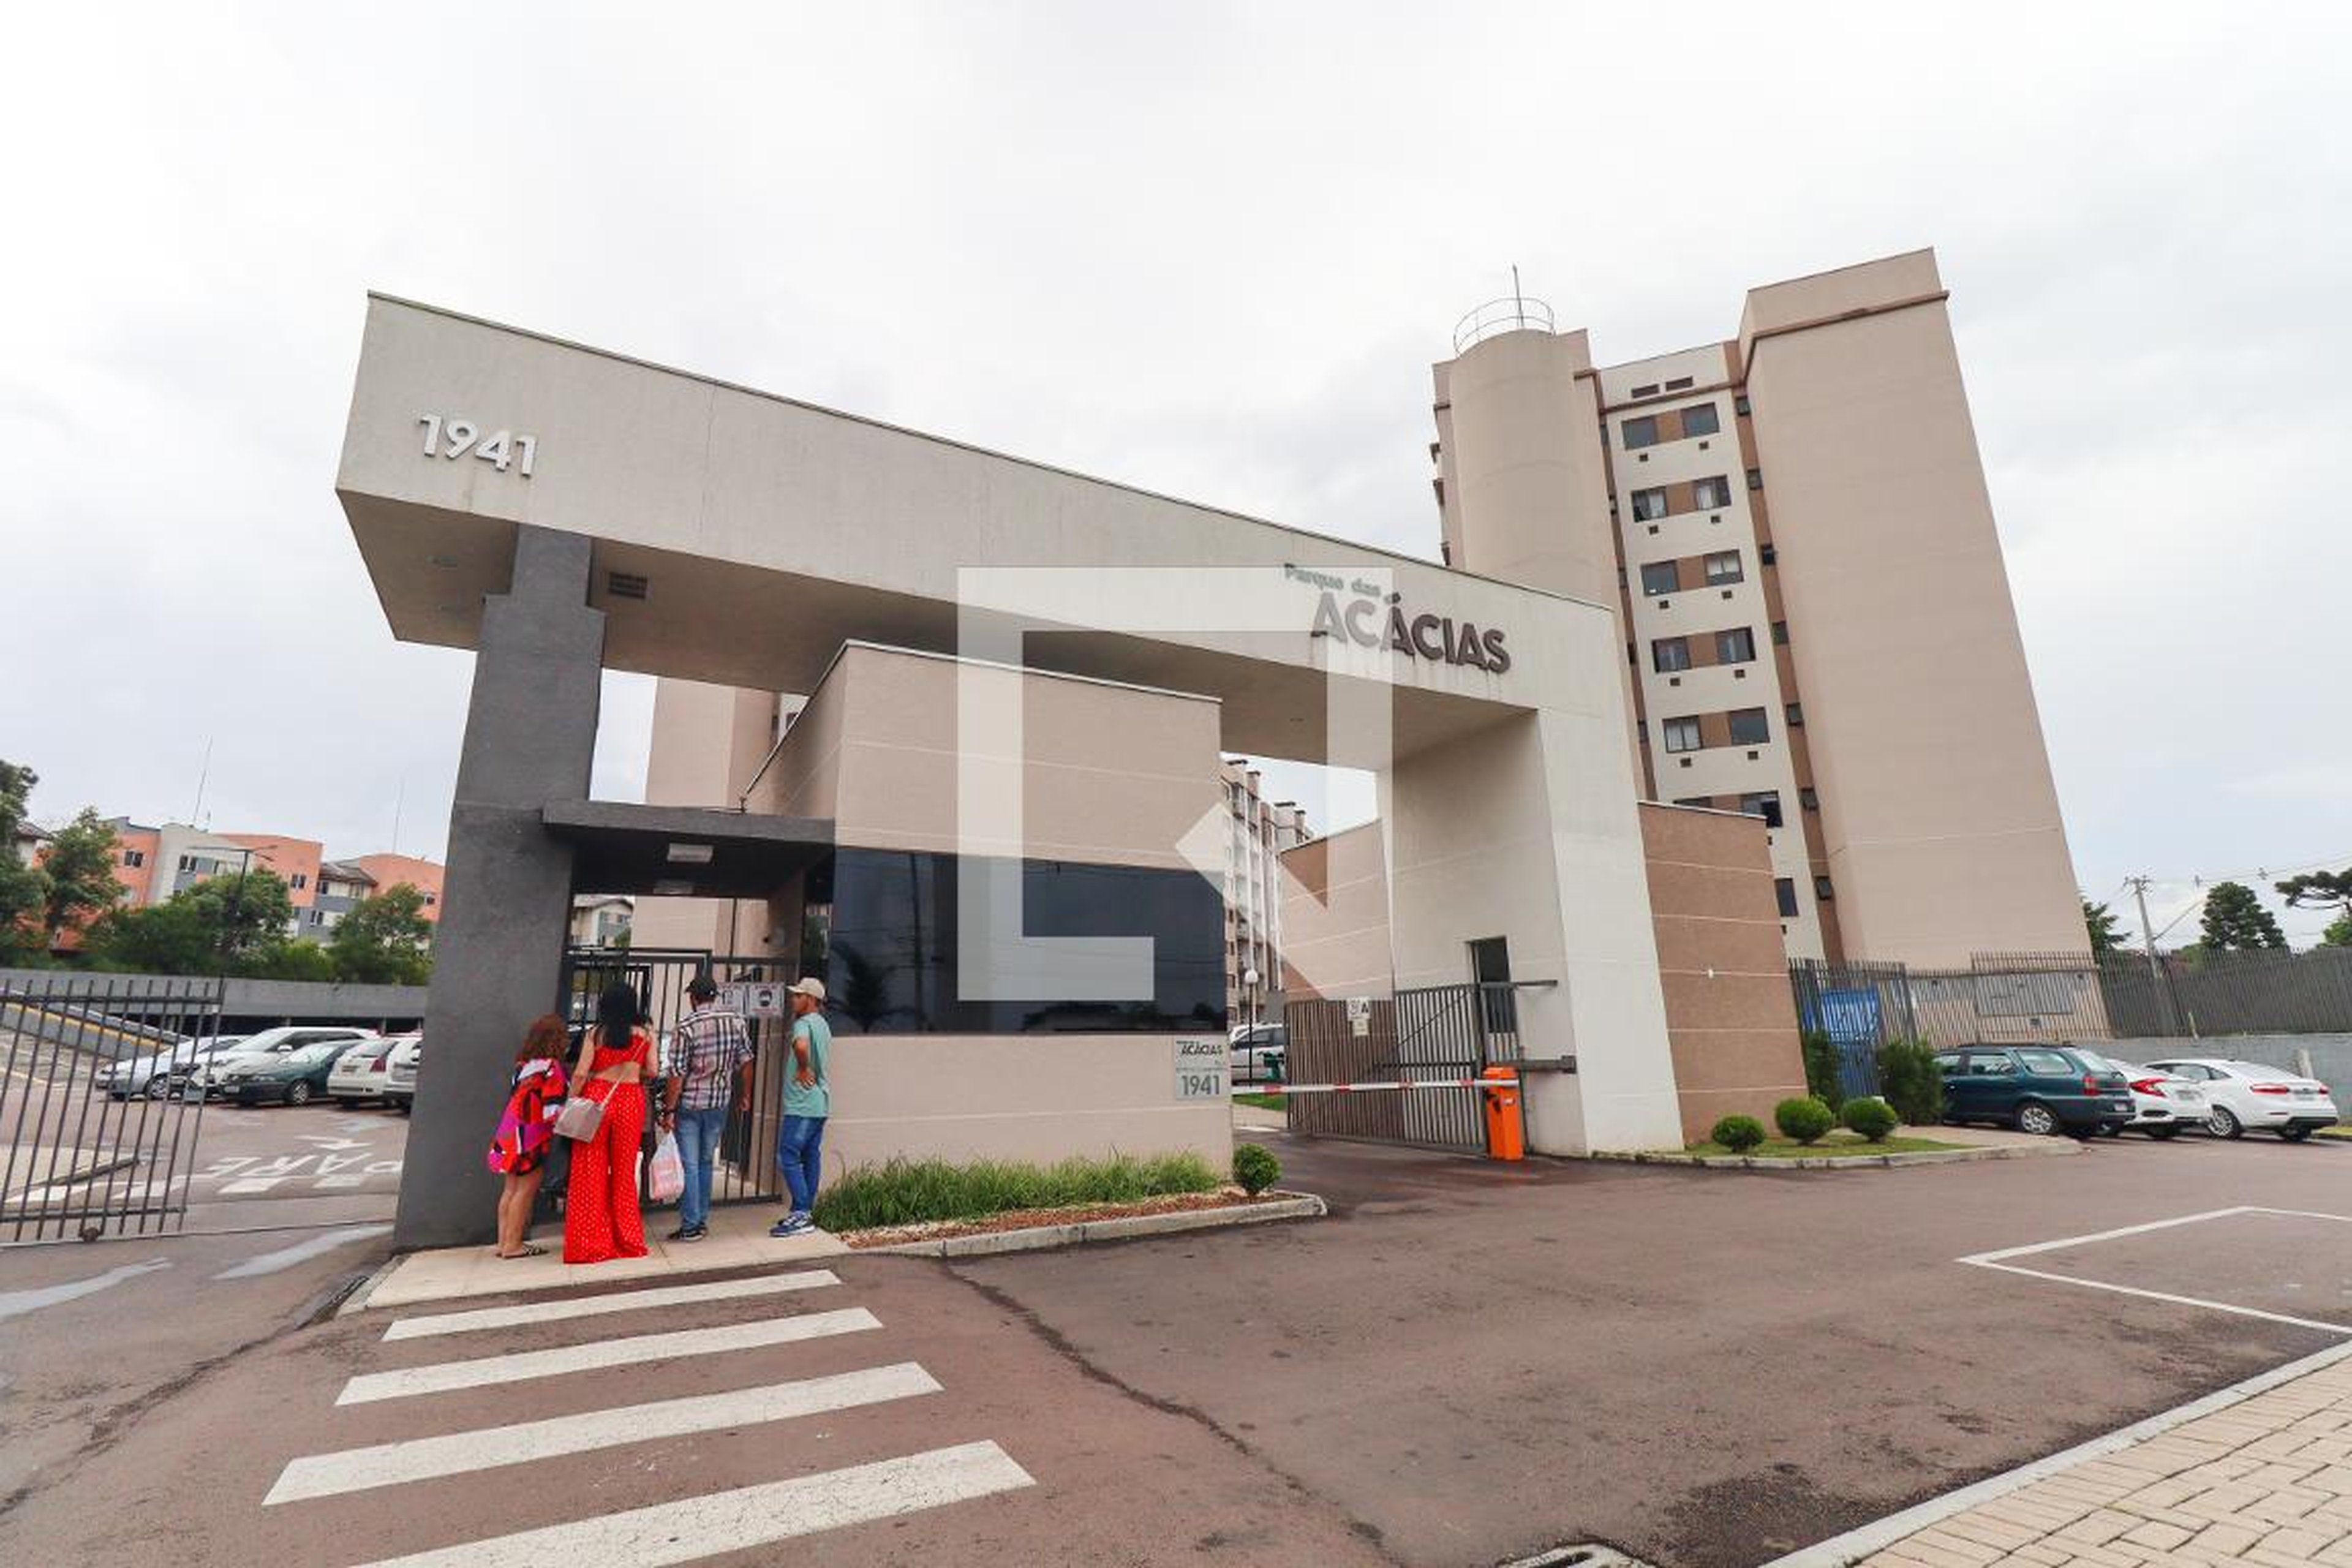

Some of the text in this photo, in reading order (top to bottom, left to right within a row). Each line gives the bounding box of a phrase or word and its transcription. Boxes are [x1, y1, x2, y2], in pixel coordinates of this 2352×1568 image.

[419, 413, 538, 478] 1941
[1284, 563, 1344, 590] Parque
[1310, 592, 1511, 674] ACÁCIAS
[1181, 1075, 1219, 1095] 1941
